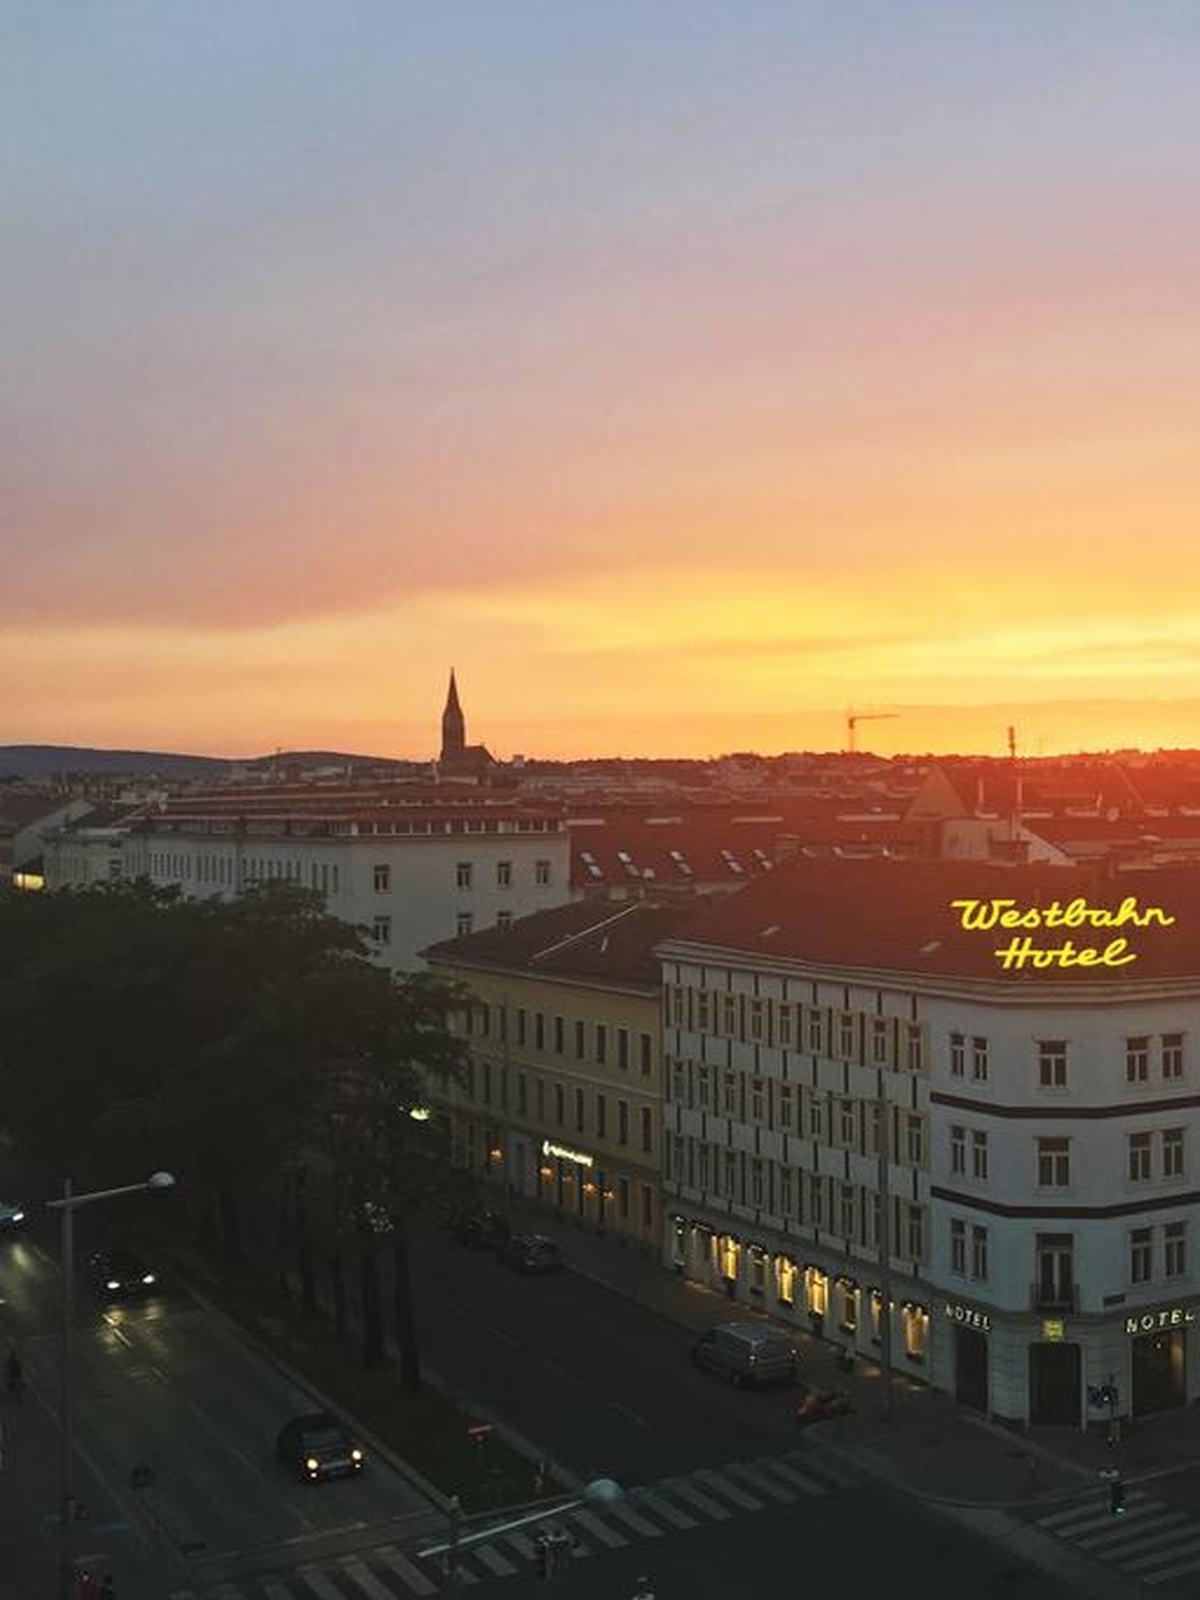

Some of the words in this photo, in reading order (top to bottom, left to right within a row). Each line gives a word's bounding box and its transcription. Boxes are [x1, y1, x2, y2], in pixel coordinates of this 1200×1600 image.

[951, 897, 1175, 930] Westbahn
[995, 937, 1137, 969] Hotel
[1126, 1309, 1195, 1333] HOTEL
